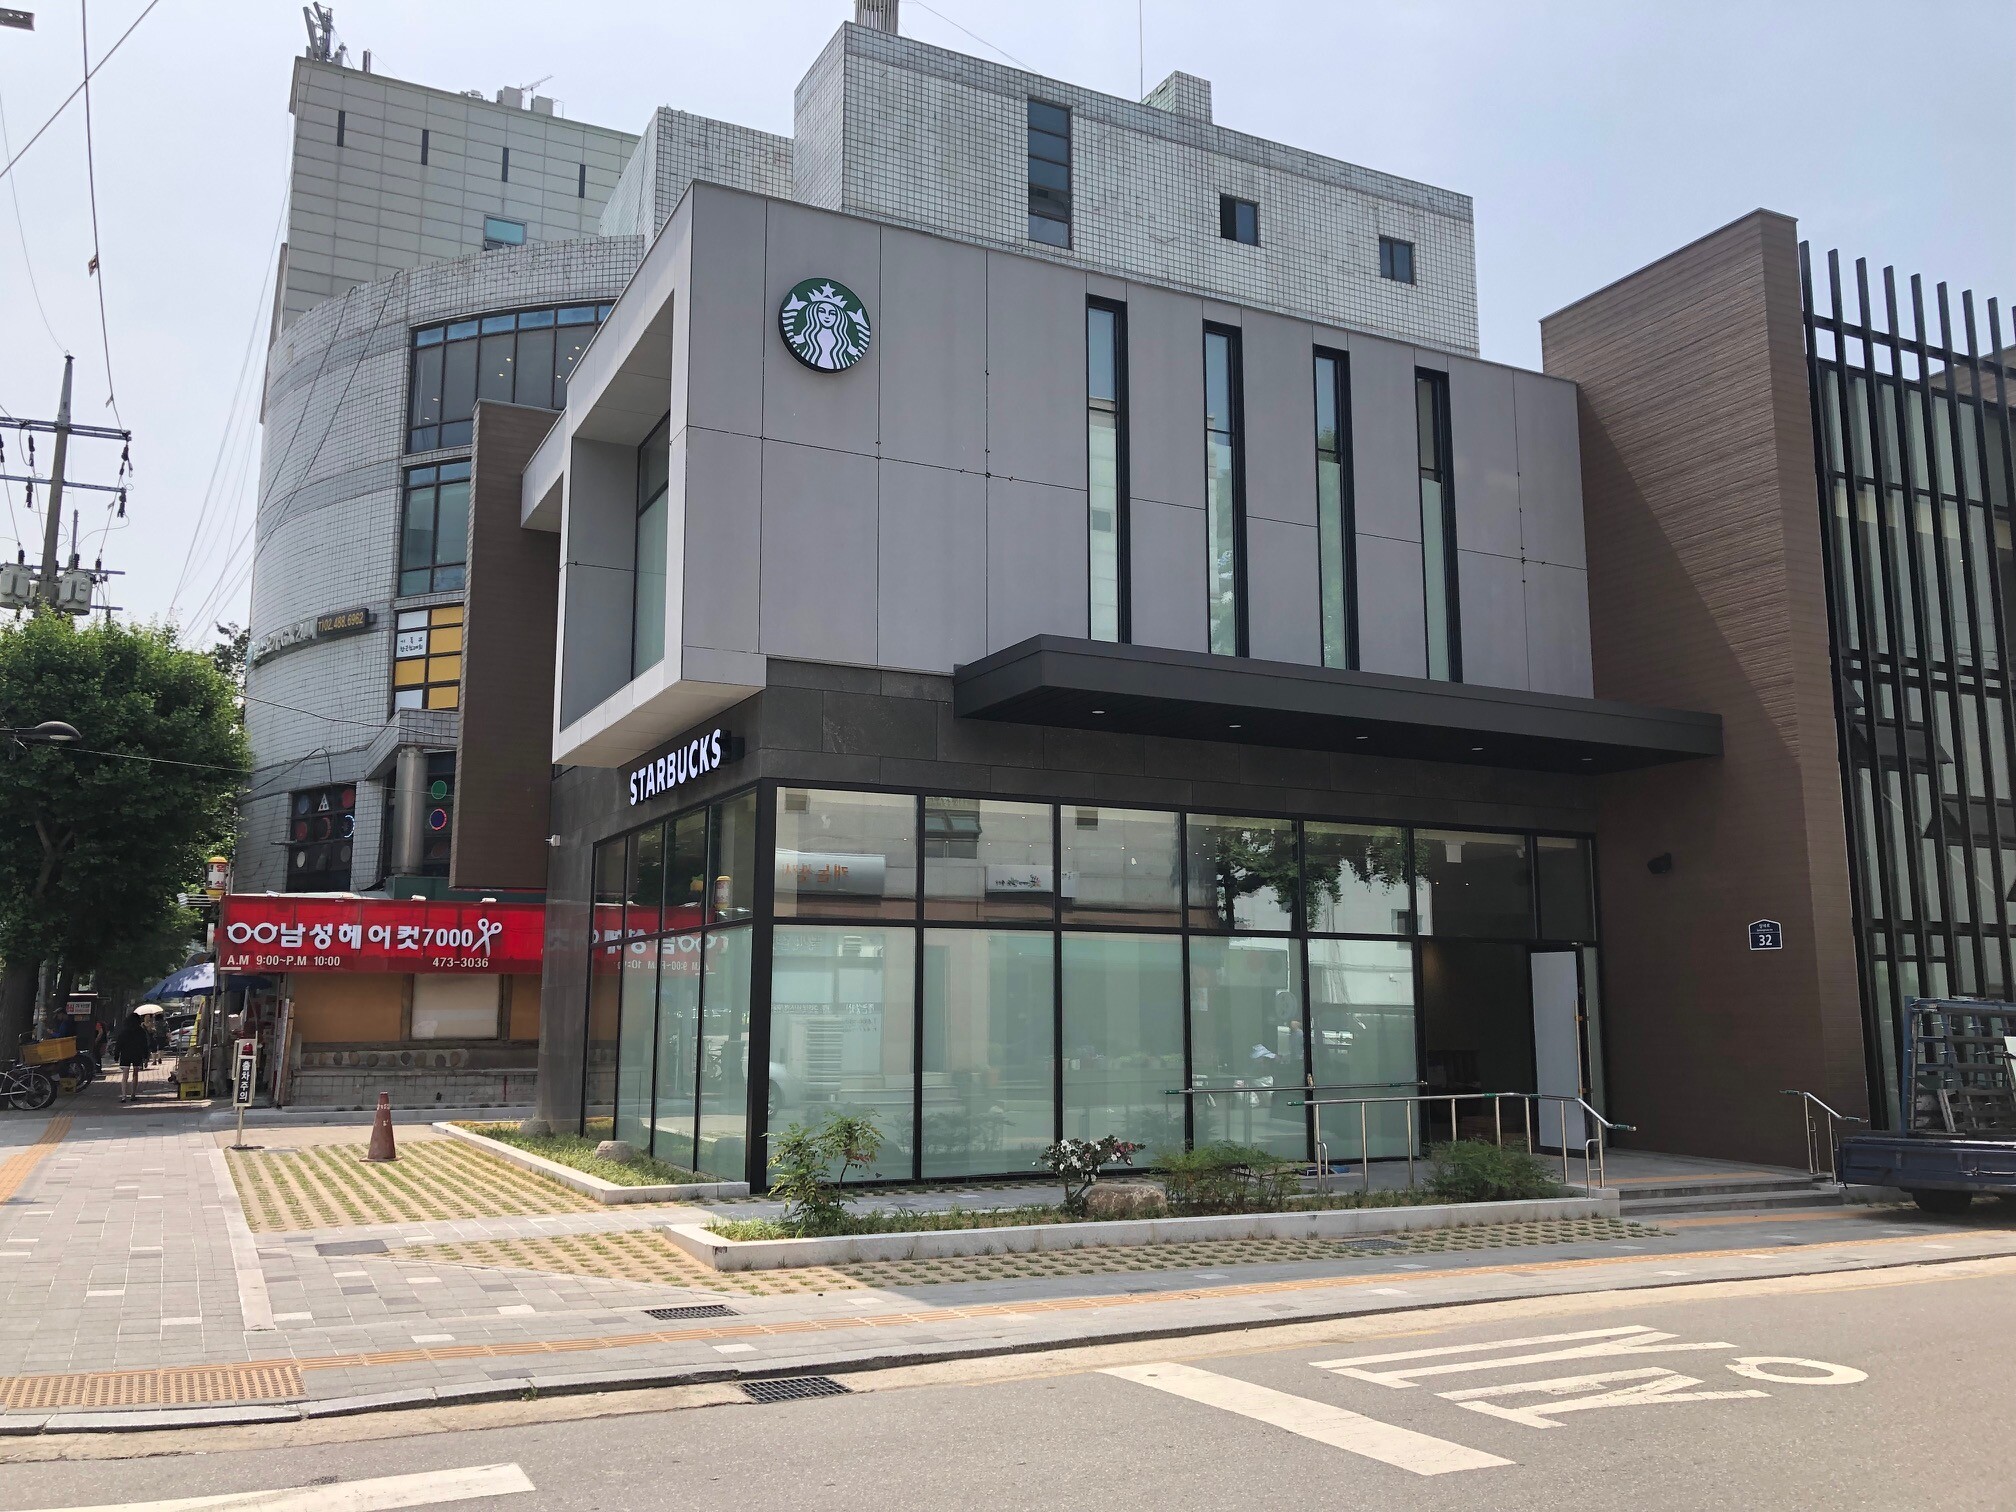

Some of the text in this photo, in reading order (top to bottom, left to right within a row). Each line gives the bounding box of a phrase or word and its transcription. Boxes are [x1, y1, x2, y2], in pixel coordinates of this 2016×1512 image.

[629, 728, 722, 807] STARBUCKS
[1759, 934, 1772, 946] 32
[227, 955, 249, 966] A.M
[314, 955, 340, 967] 10:00
[432, 956, 489, 968] 473-3036
[239, 1060, 251, 1101] 출차주의
